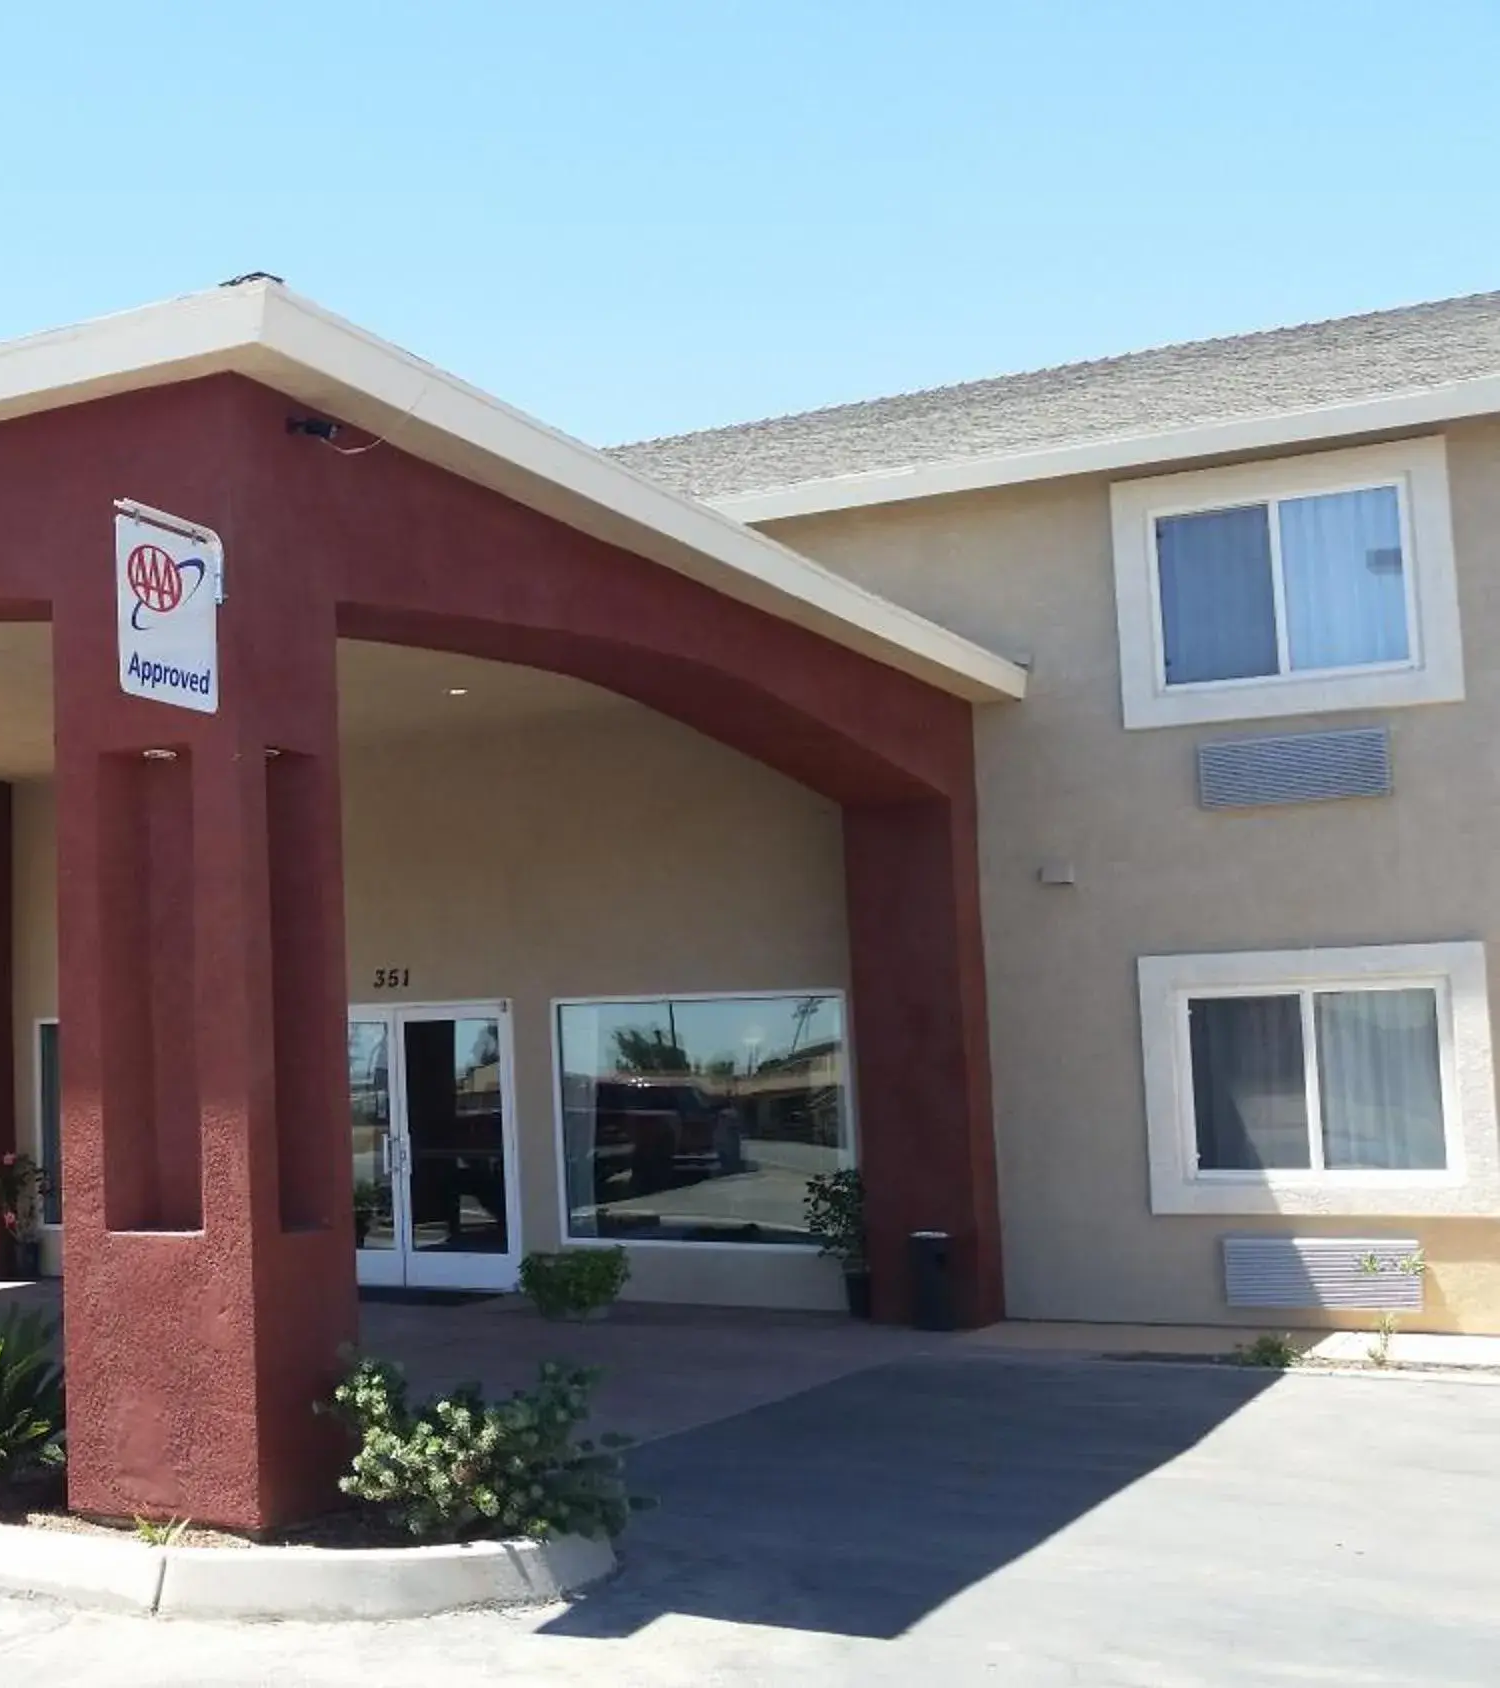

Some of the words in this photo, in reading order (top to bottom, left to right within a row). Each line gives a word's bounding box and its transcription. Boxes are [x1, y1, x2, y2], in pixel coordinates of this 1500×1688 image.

[133, 548, 180, 608] AAA
[128, 651, 211, 694] Approved
[373, 969, 409, 988] 351
